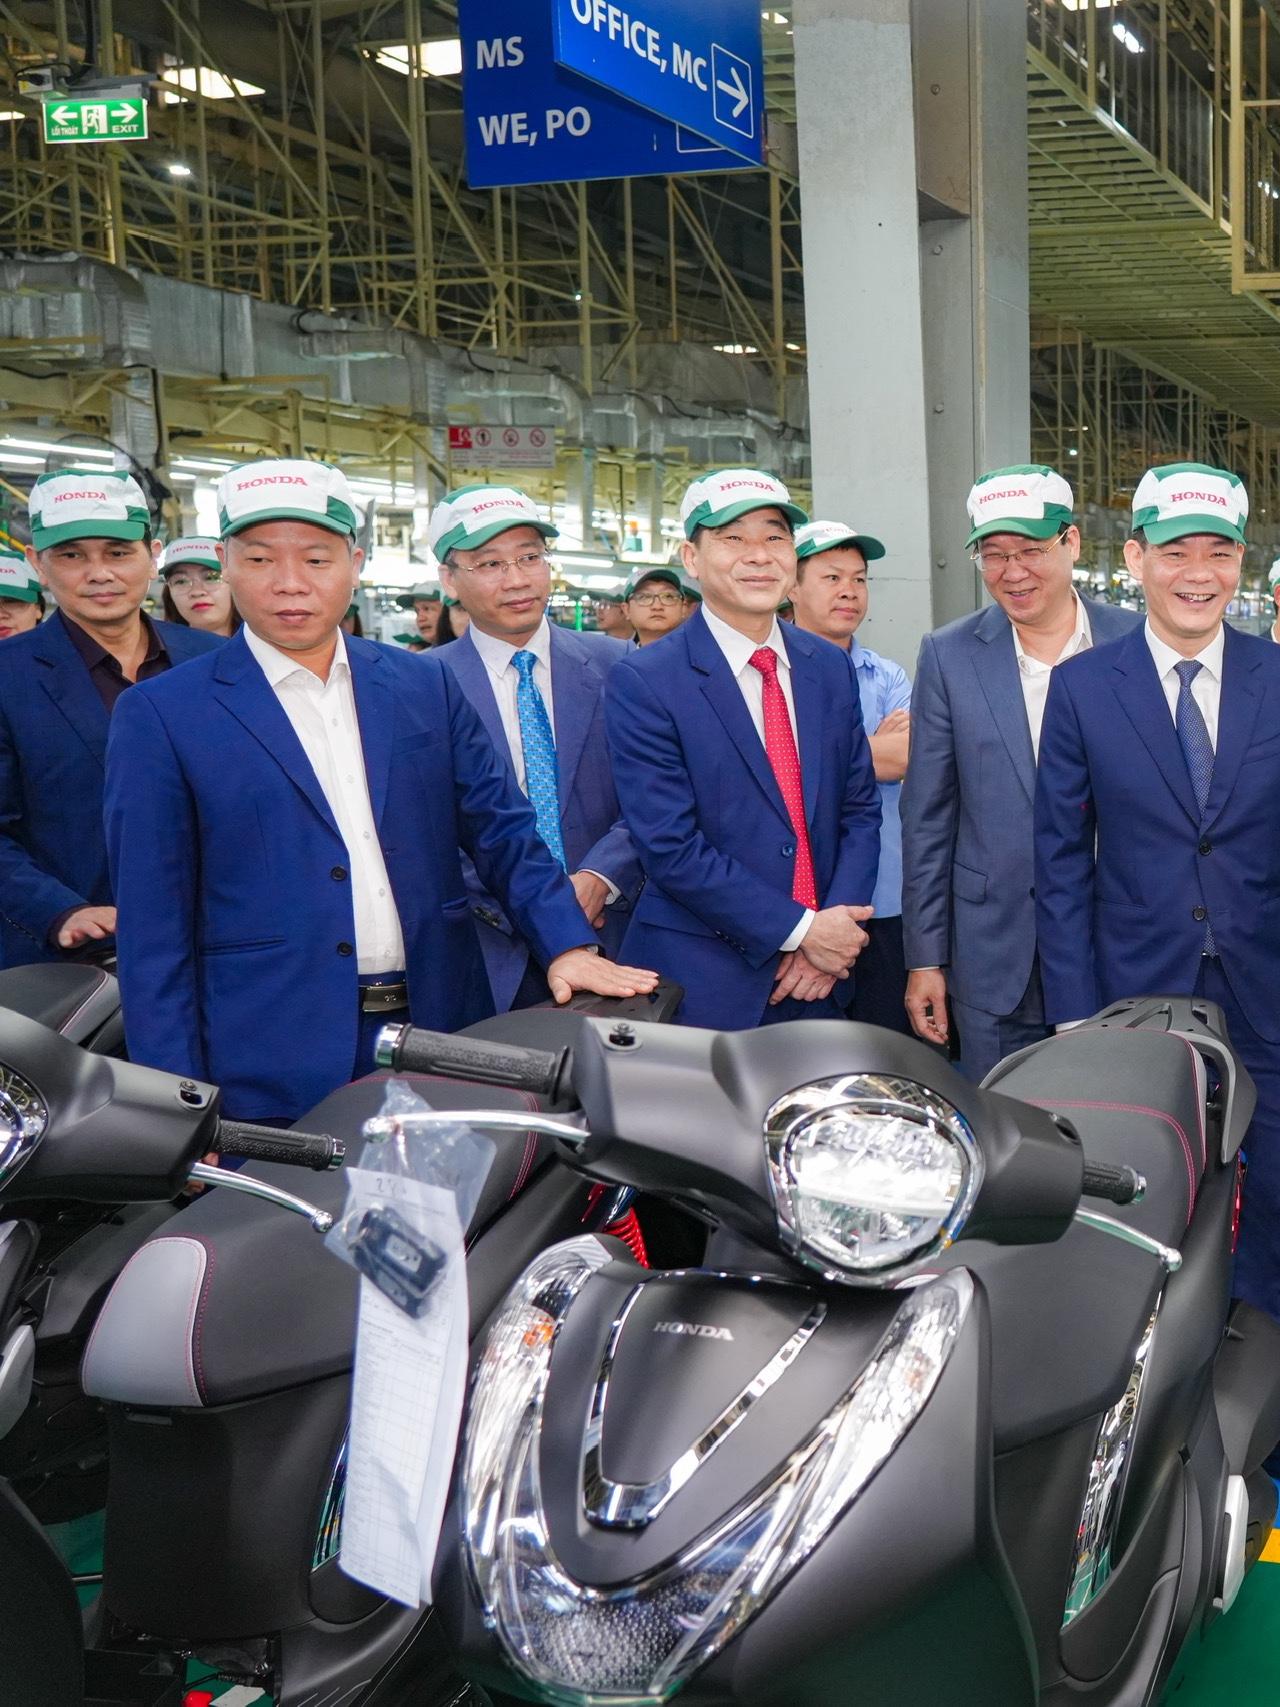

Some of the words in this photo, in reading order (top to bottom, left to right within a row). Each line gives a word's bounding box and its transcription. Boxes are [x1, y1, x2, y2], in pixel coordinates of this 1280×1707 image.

[476, 36, 525, 69] MS
[570, 0, 668, 73] OFFICE,
[672, 41, 708, 92] MC
[112, 124, 139, 134] EXIT
[478, 112, 537, 147] WE,
[546, 106, 592, 139] PO
[238, 475, 308, 492] HONDA
[720, 481, 775, 493] HONDA
[54, 491, 107, 504] HONDA
[980, 488, 1029, 505] HONDA
[1170, 491, 1229, 507] HONDA
[472, 500, 524, 515] HONDA
[171, 544, 211, 553] HONDA
[653, 1321, 735, 1341] HONDA
